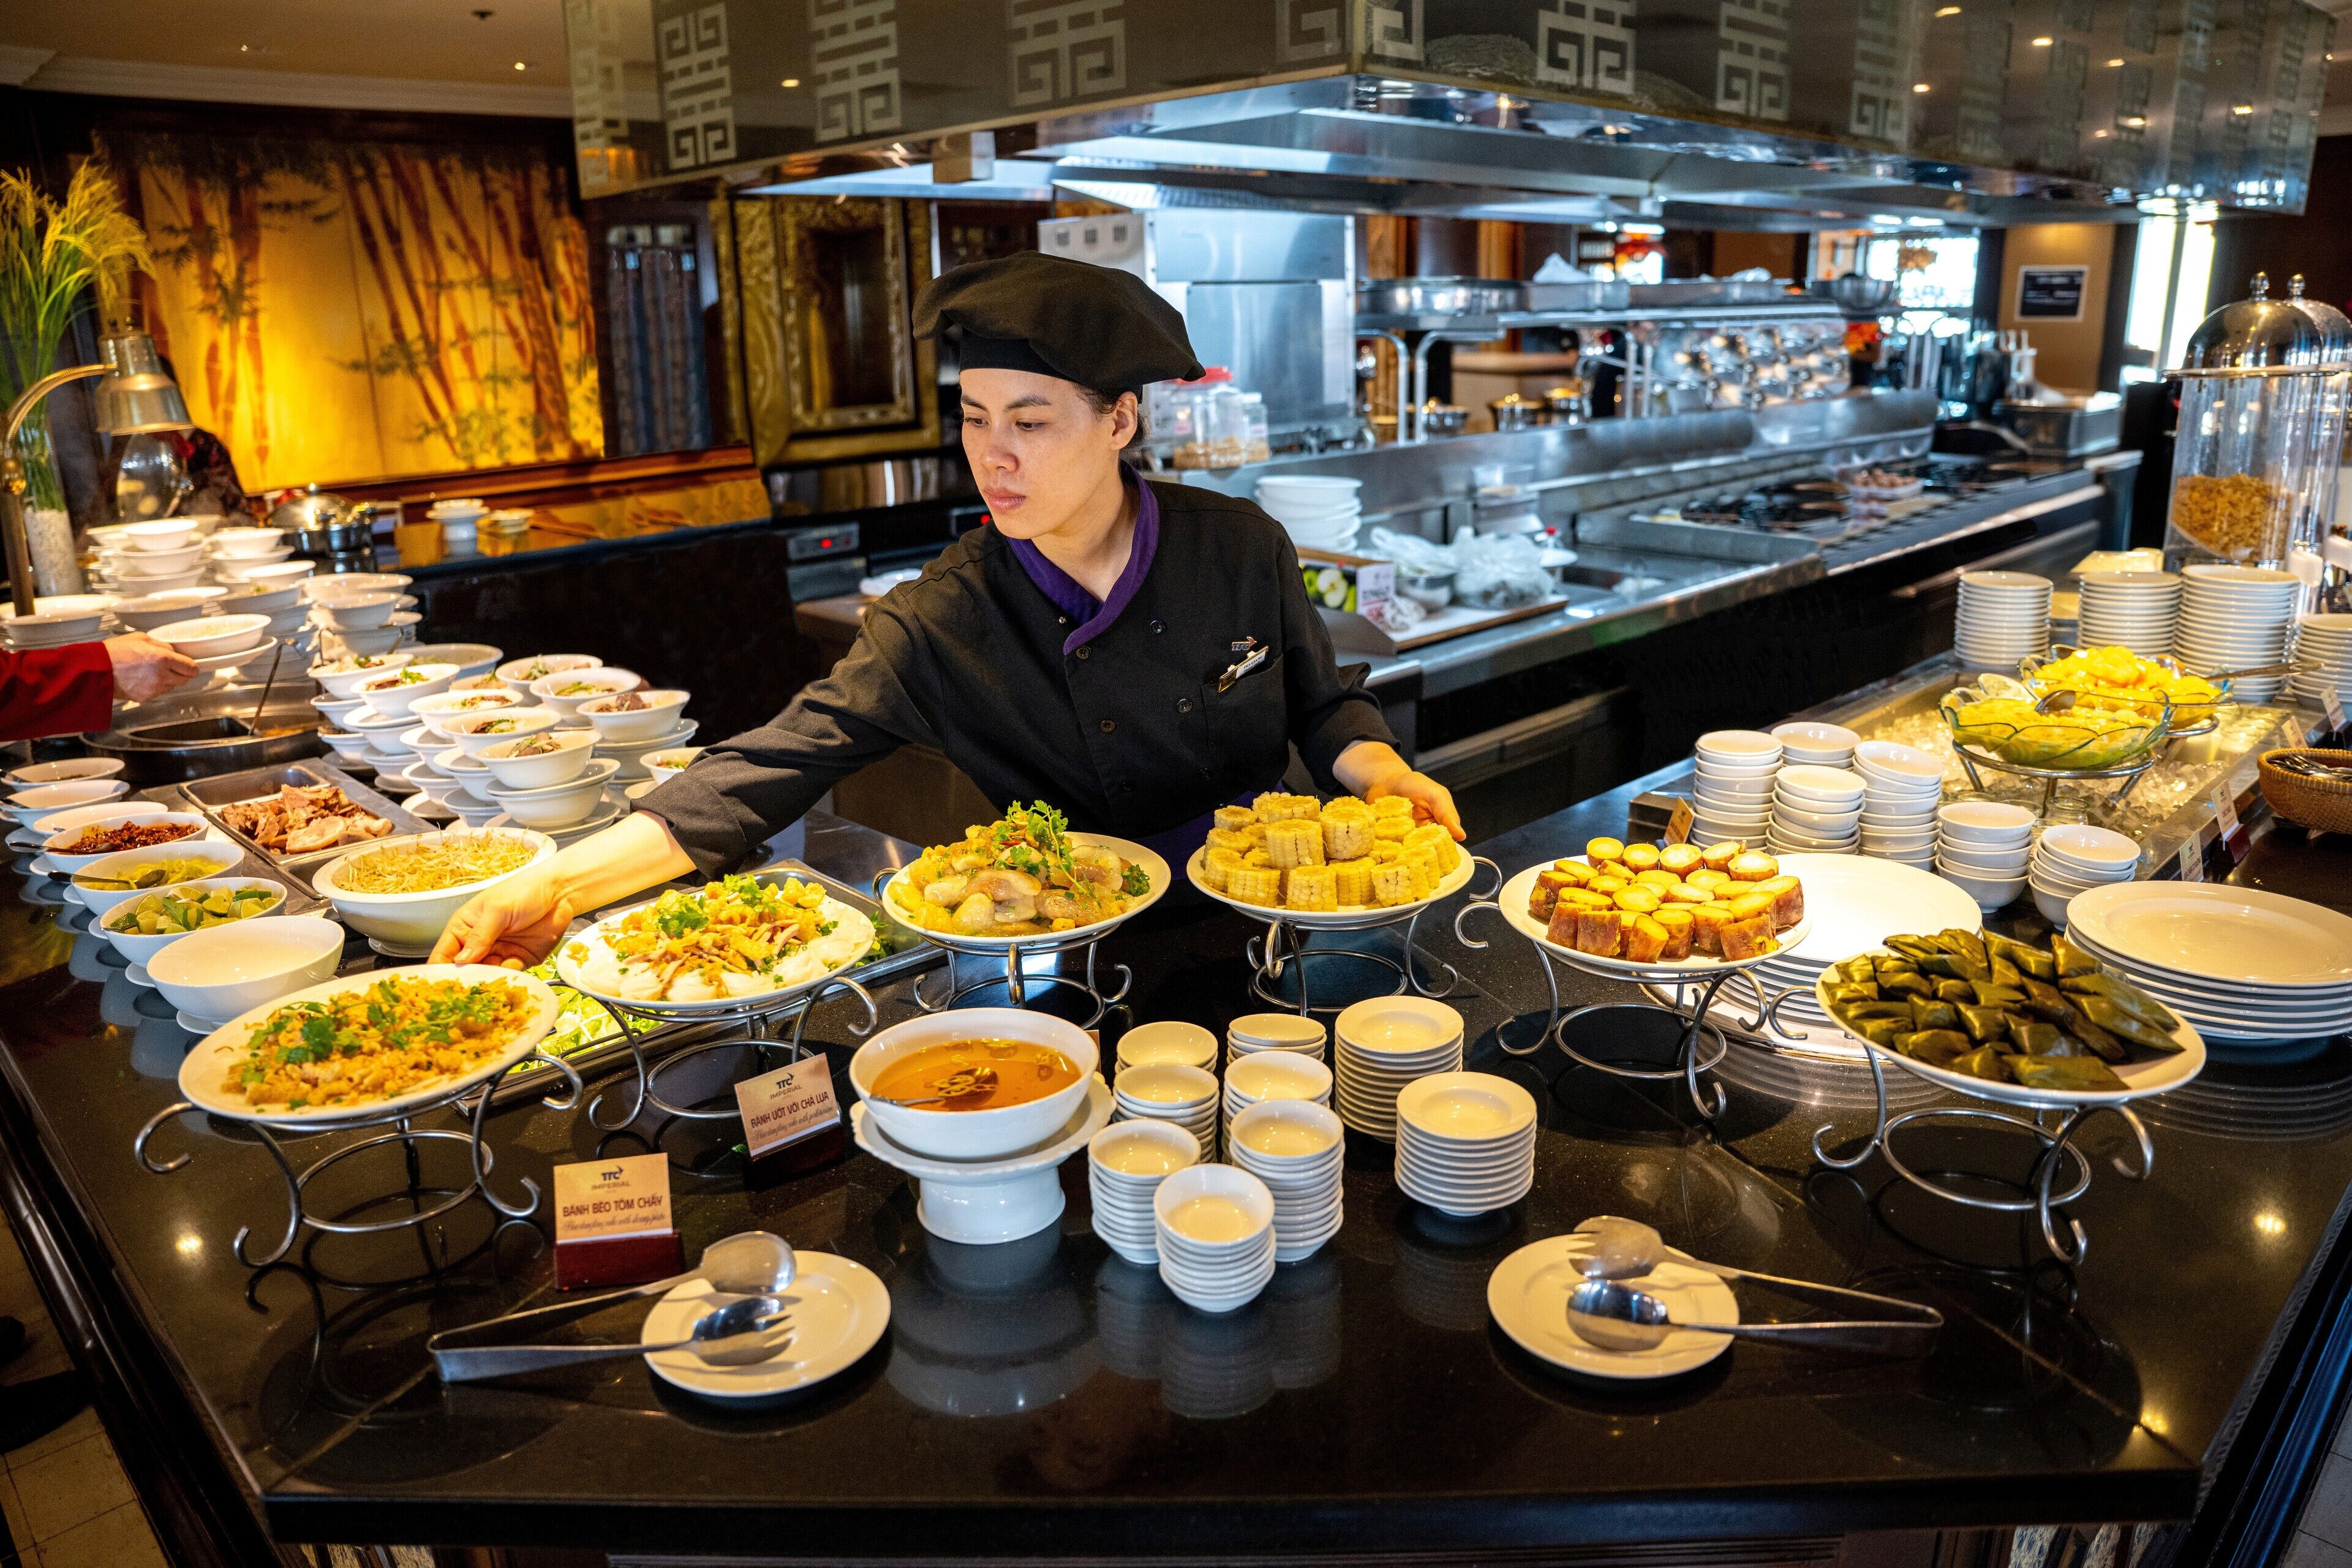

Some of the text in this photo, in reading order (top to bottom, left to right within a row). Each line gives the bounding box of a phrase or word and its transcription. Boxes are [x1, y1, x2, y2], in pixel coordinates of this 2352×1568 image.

[776, 1078, 793, 1089] TTC
[770, 1084, 802, 1099] IMPERIAL
[751, 1114, 771, 1128] BÁNH
[816, 1091, 829, 1103] LỤA
[601, 1171, 620, 1181] TTC
